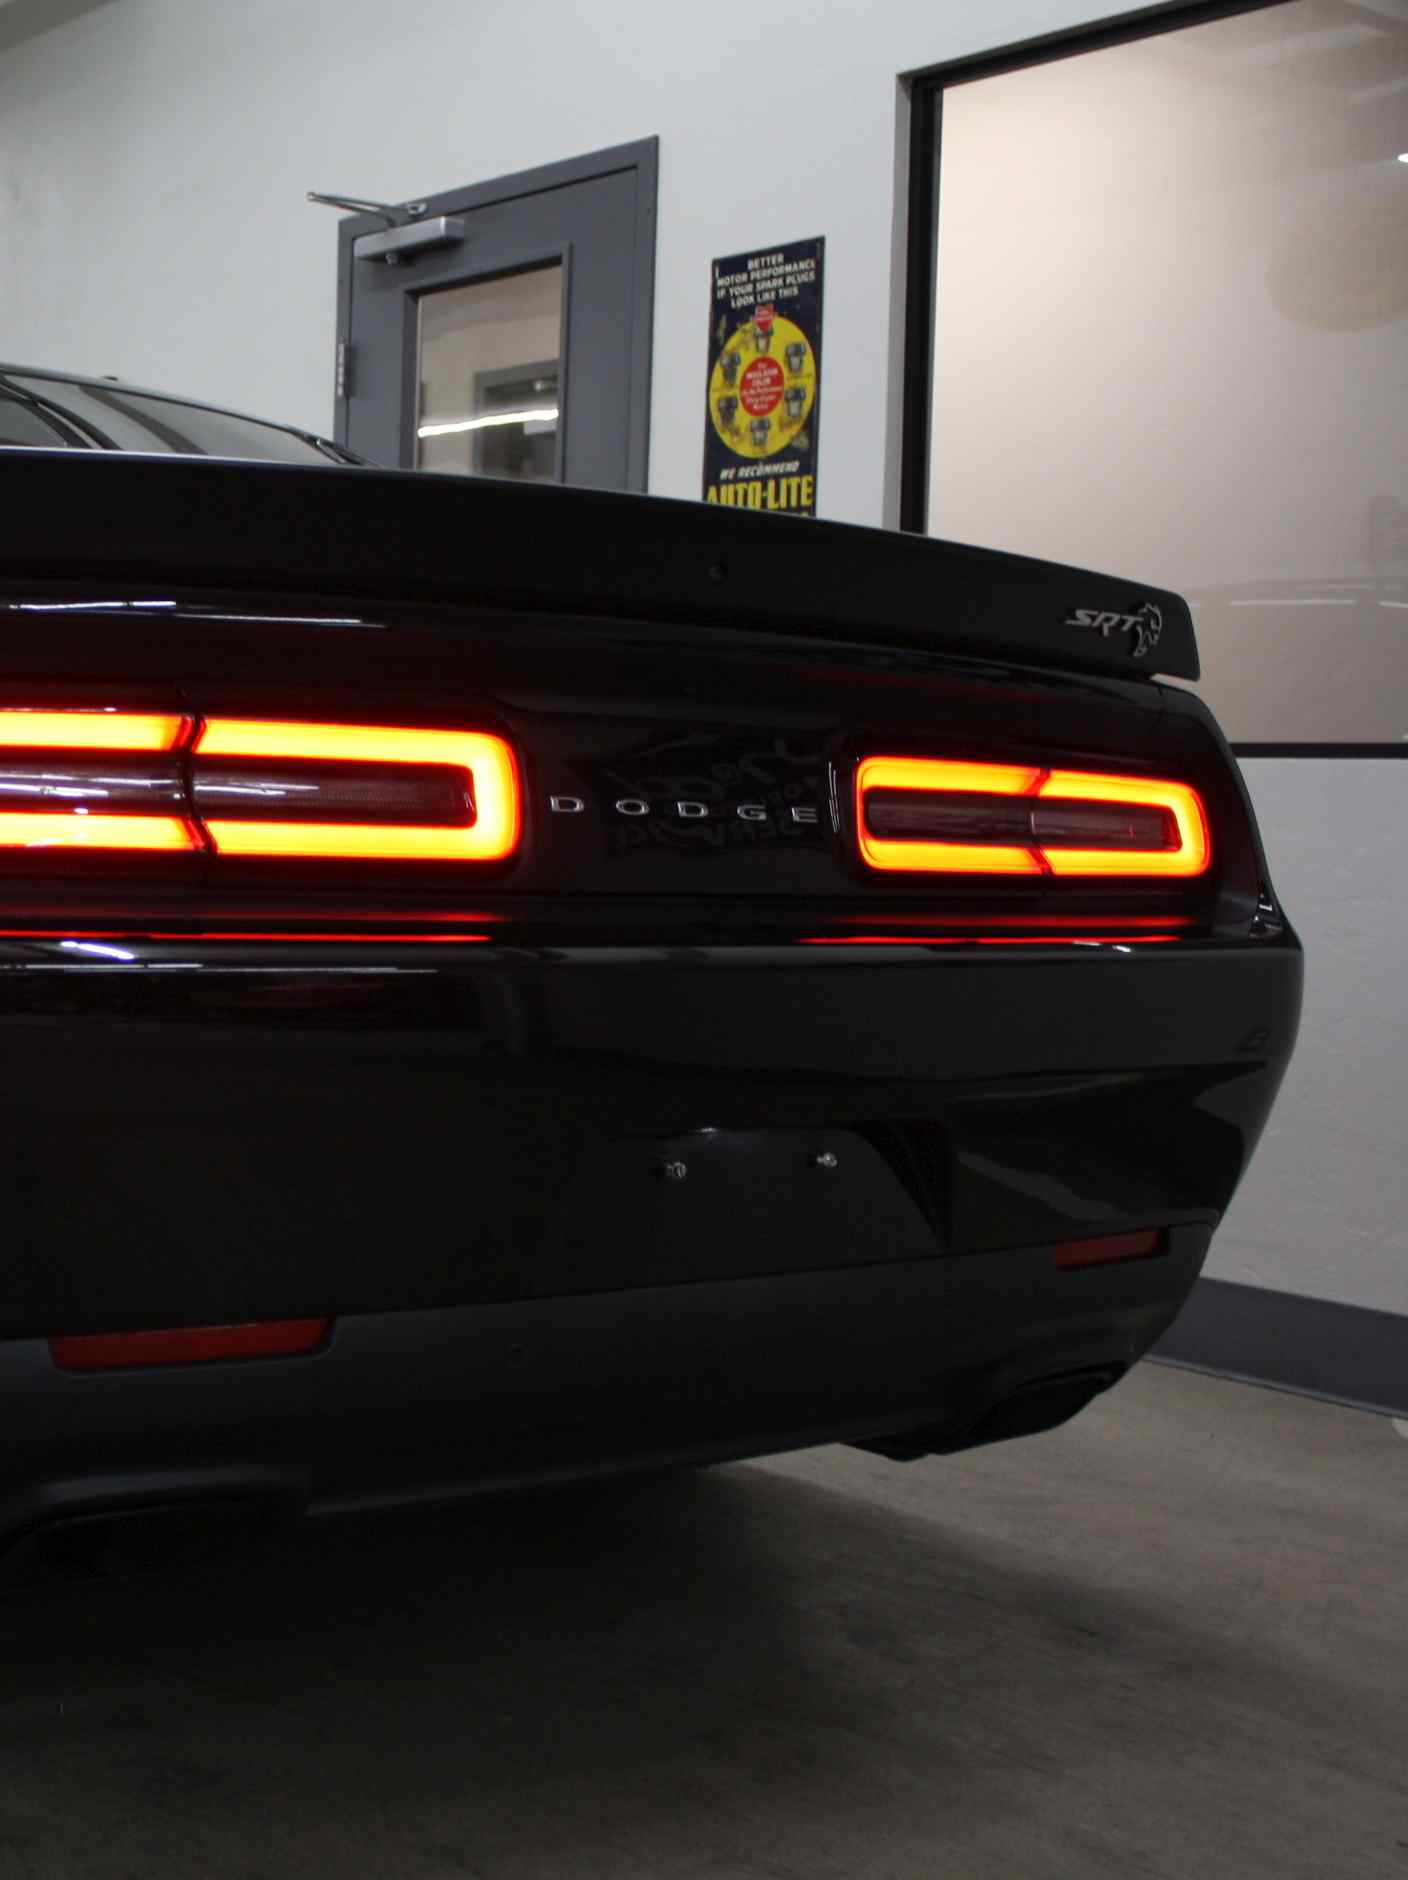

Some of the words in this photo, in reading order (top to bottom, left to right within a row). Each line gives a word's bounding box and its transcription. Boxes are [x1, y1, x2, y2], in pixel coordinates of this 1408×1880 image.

[717, 272, 748, 287] MOTOR
[750, 259, 816, 280] PERFORMANCE
[748, 253, 784, 270] BETTER
[717, 287, 727, 299] IF
[729, 283, 753, 297] YOUR
[756, 277, 784, 293] SPARK
[786, 270, 815, 285] PLUGS
[731, 294, 755, 309] LOOK
[757, 289, 776, 303] LIKE
[779, 285, 799, 298] THIS
[720, 467, 736, 480] WE
[737, 460, 800, 478] RECOMMEND
[707, 475, 813, 510] AUTO-LITE
[1065, 608, 1144, 637] SRT
[549, 795, 819, 823] DODGE
